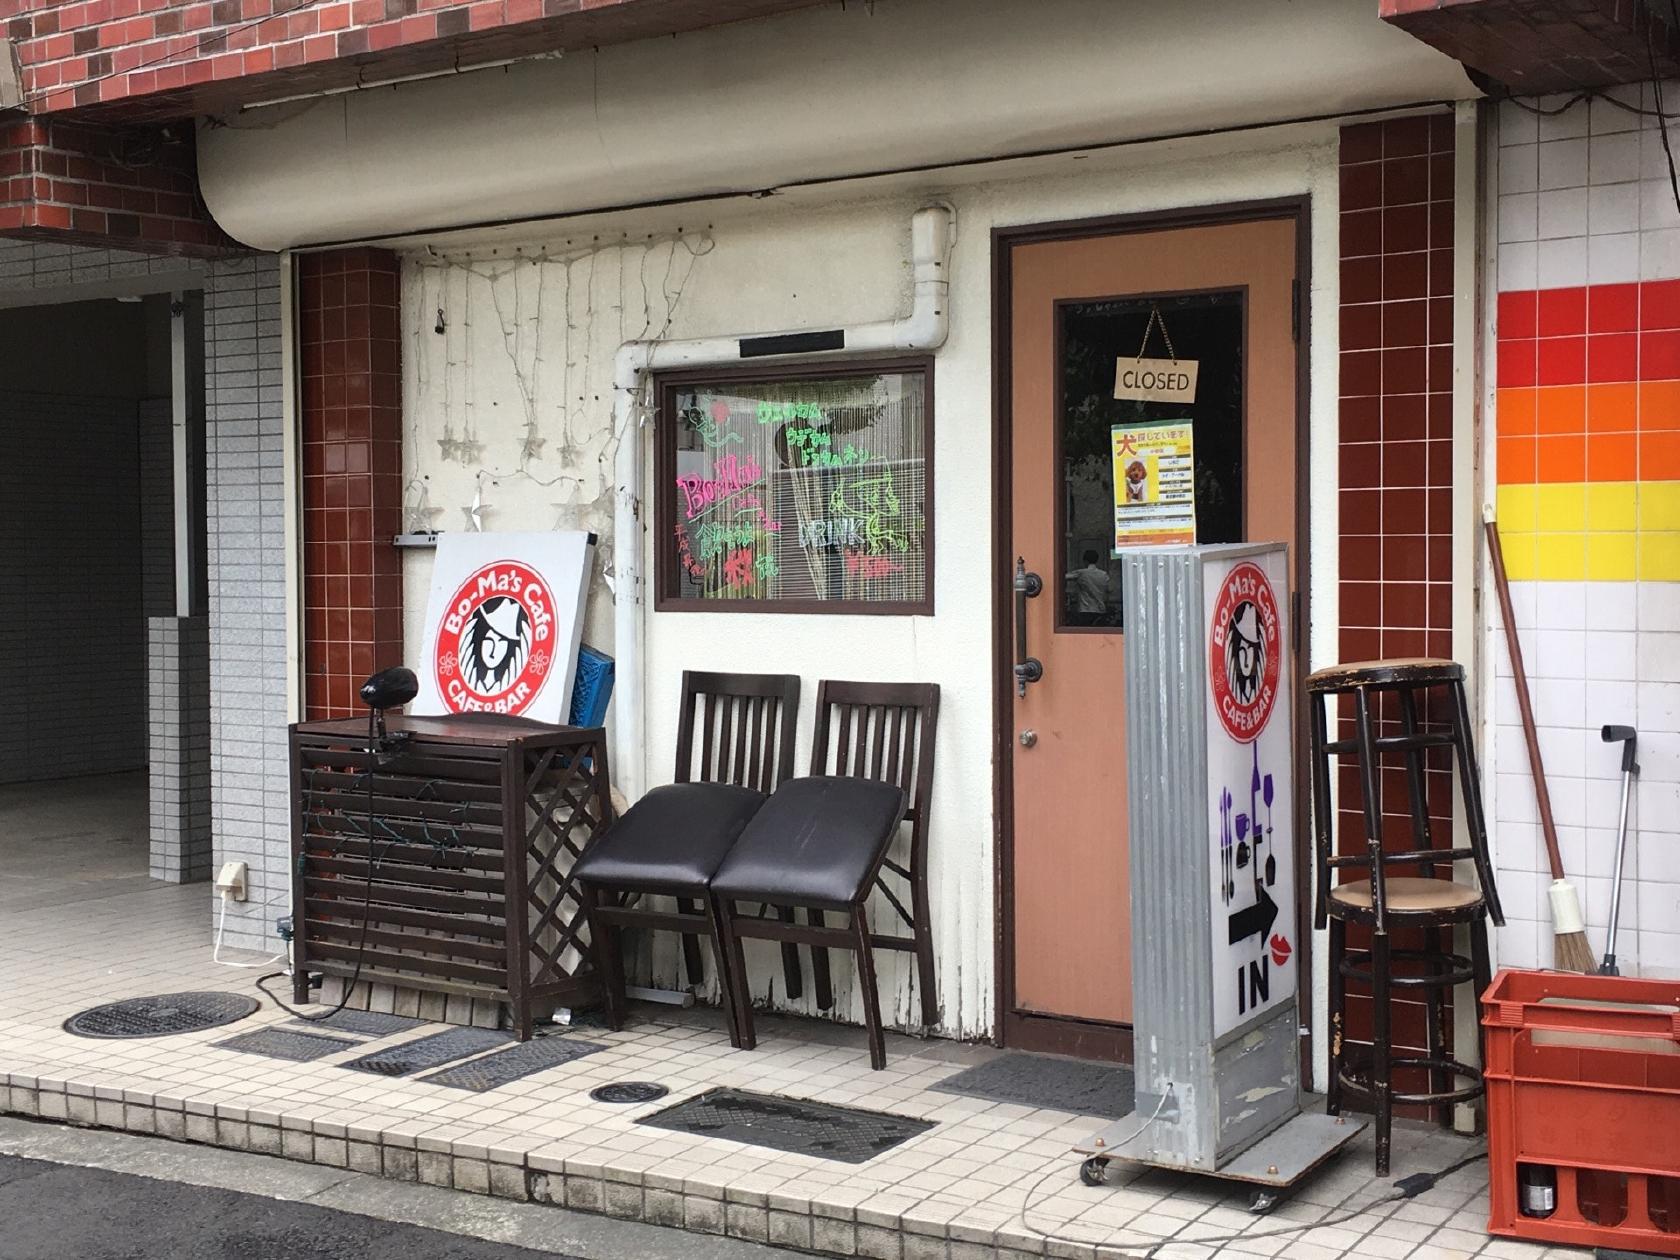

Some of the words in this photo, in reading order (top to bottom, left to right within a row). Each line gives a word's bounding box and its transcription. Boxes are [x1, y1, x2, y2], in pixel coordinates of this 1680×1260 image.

[1122, 370, 1190, 392] CLOSED
[1115, 434, 1137, 458] 犬
[798, 517, 866, 547] DRINK
[444, 569, 523, 635] Bo-Ma's
[523, 583, 553, 641] Cafe
[1213, 572, 1256, 647] Bo-Ma's
[1256, 585, 1276, 642] Cafe
[1237, 954, 1270, 1017] IN
